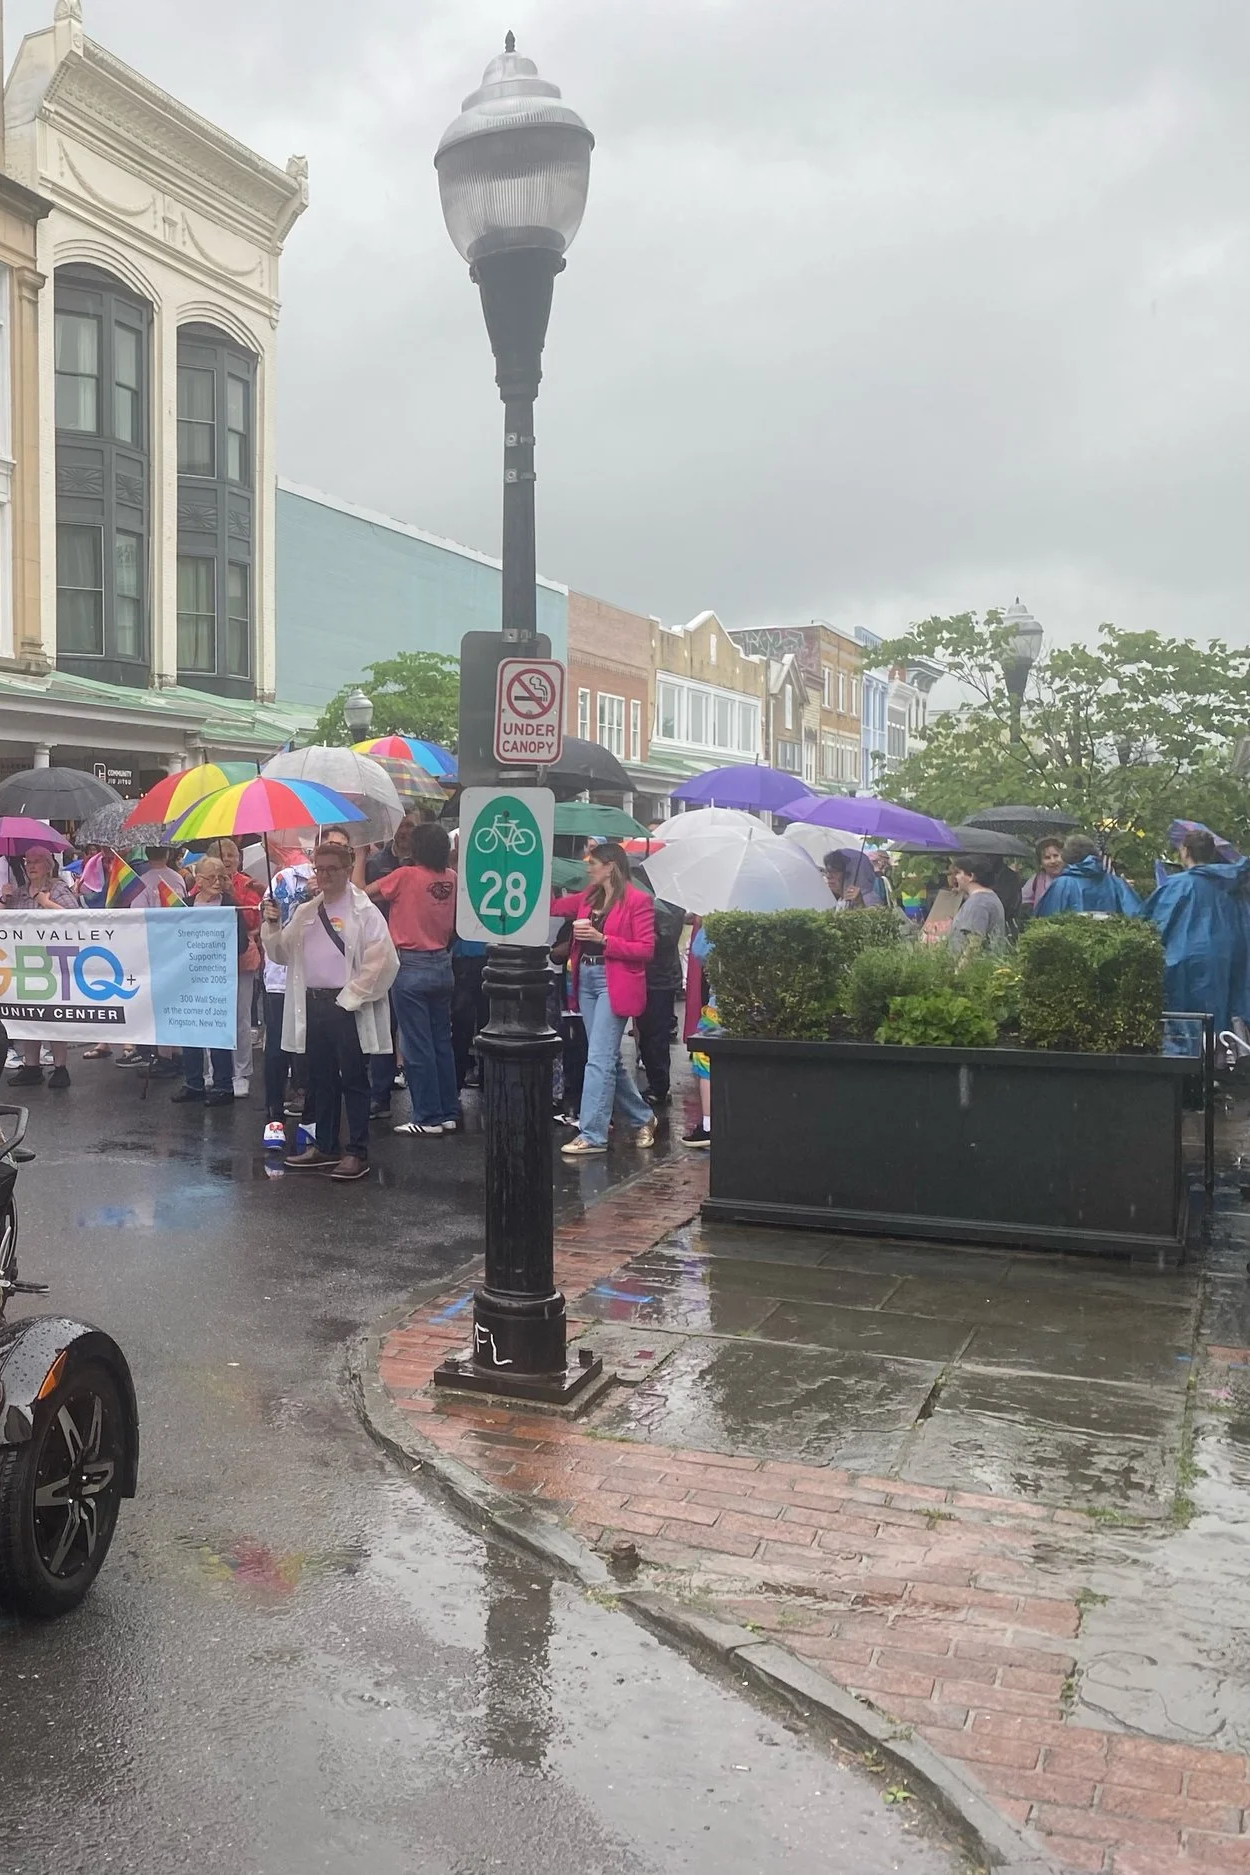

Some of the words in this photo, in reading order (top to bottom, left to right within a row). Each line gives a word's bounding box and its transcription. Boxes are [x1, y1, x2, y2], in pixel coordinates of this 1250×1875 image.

[503, 723, 555, 737] UNDER
[502, 740, 554, 754] CANOPY
[479, 870, 527, 918] 28
[36, 929, 116, 941] VALLEY
[178, 929, 225, 939] Strengthening
[187, 941, 227, 950] Celebrating
[189, 952, 227, 962] Supporting
[189, 964, 227, 974] Connecting
[191, 976, 209, 984] since
[211, 975, 227, 984] 2005
[180, 995, 193, 1003] 300
[195, 995, 208, 1004] Wall
[209, 995, 227, 1005] Street
[53, 1008, 118, 1020] CENTER
[171, 1007, 182, 1015] the
[205, 1007, 212, 1015] of
[213, 1008, 228, 1016] John
[168, 1018, 198, 1028] Kingston,
[199, 1019, 214, 1028] New
[215, 1019, 227, 1028] York
